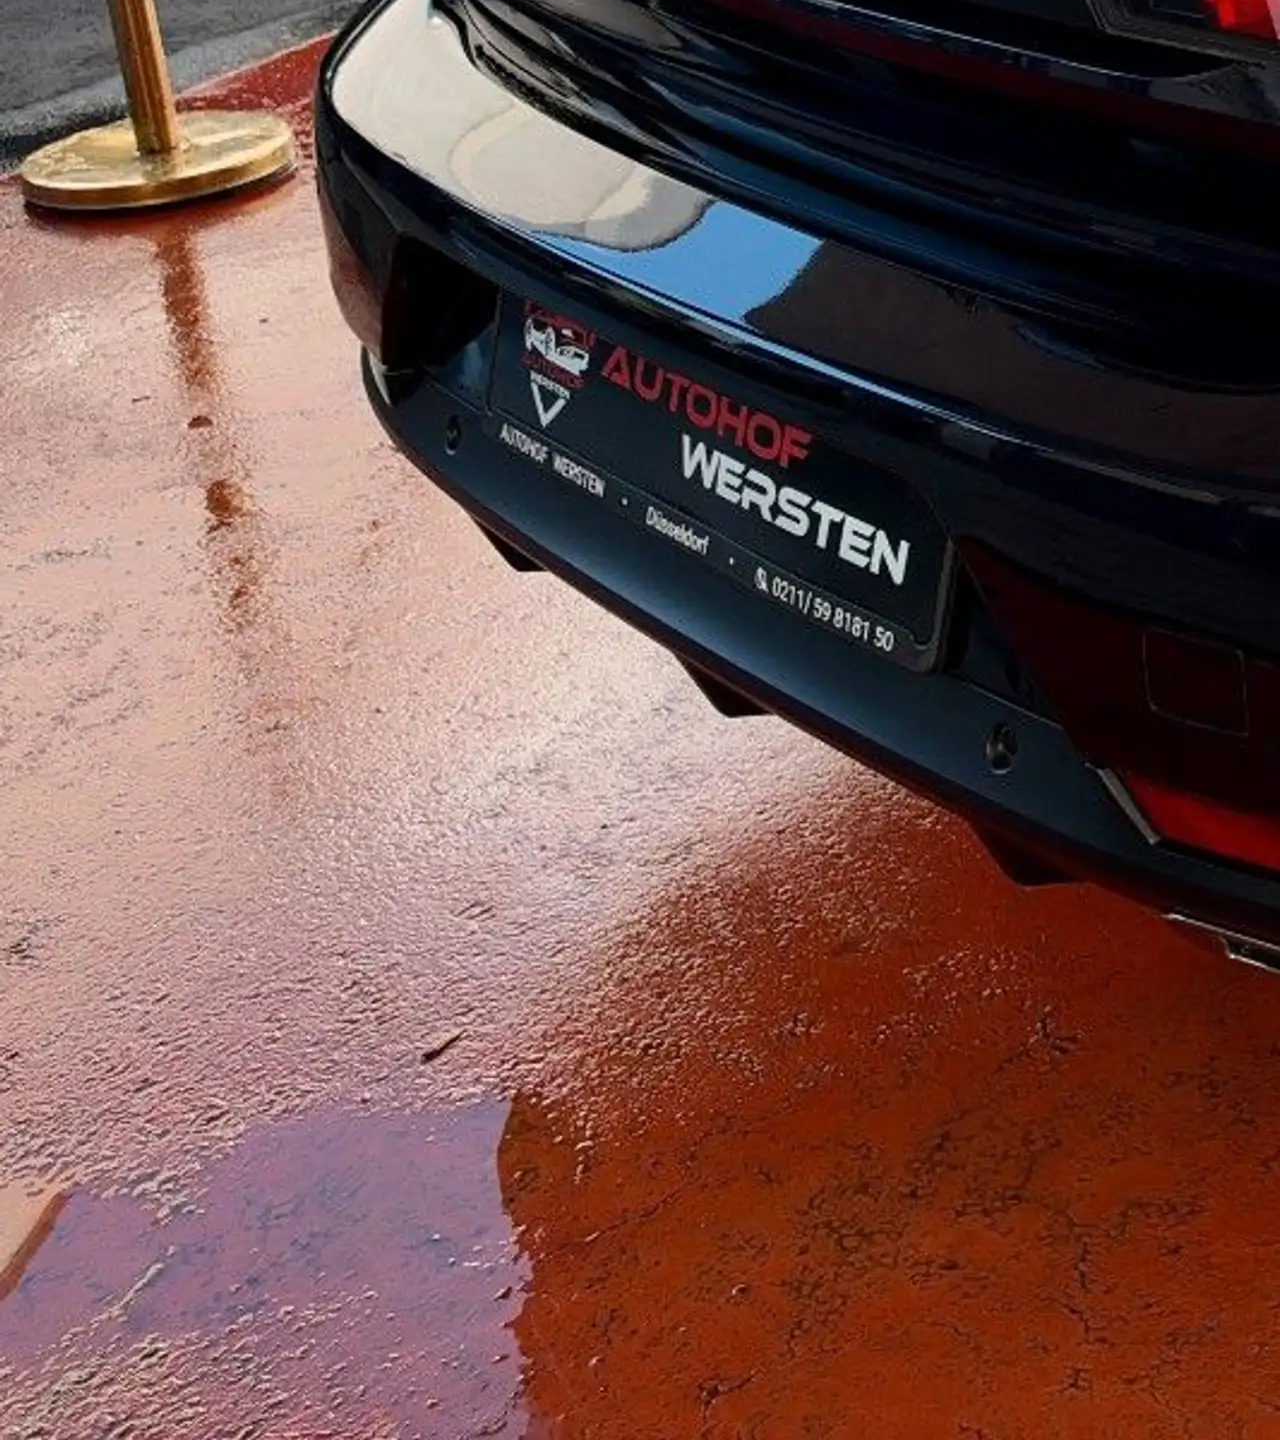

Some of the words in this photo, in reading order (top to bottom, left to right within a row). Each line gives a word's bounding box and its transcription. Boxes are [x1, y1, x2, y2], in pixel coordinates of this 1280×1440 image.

[602, 345, 814, 470] AUTOHOF
[645, 506, 710, 556] Düsseldorf
[682, 433, 912, 586] WERSTEN
